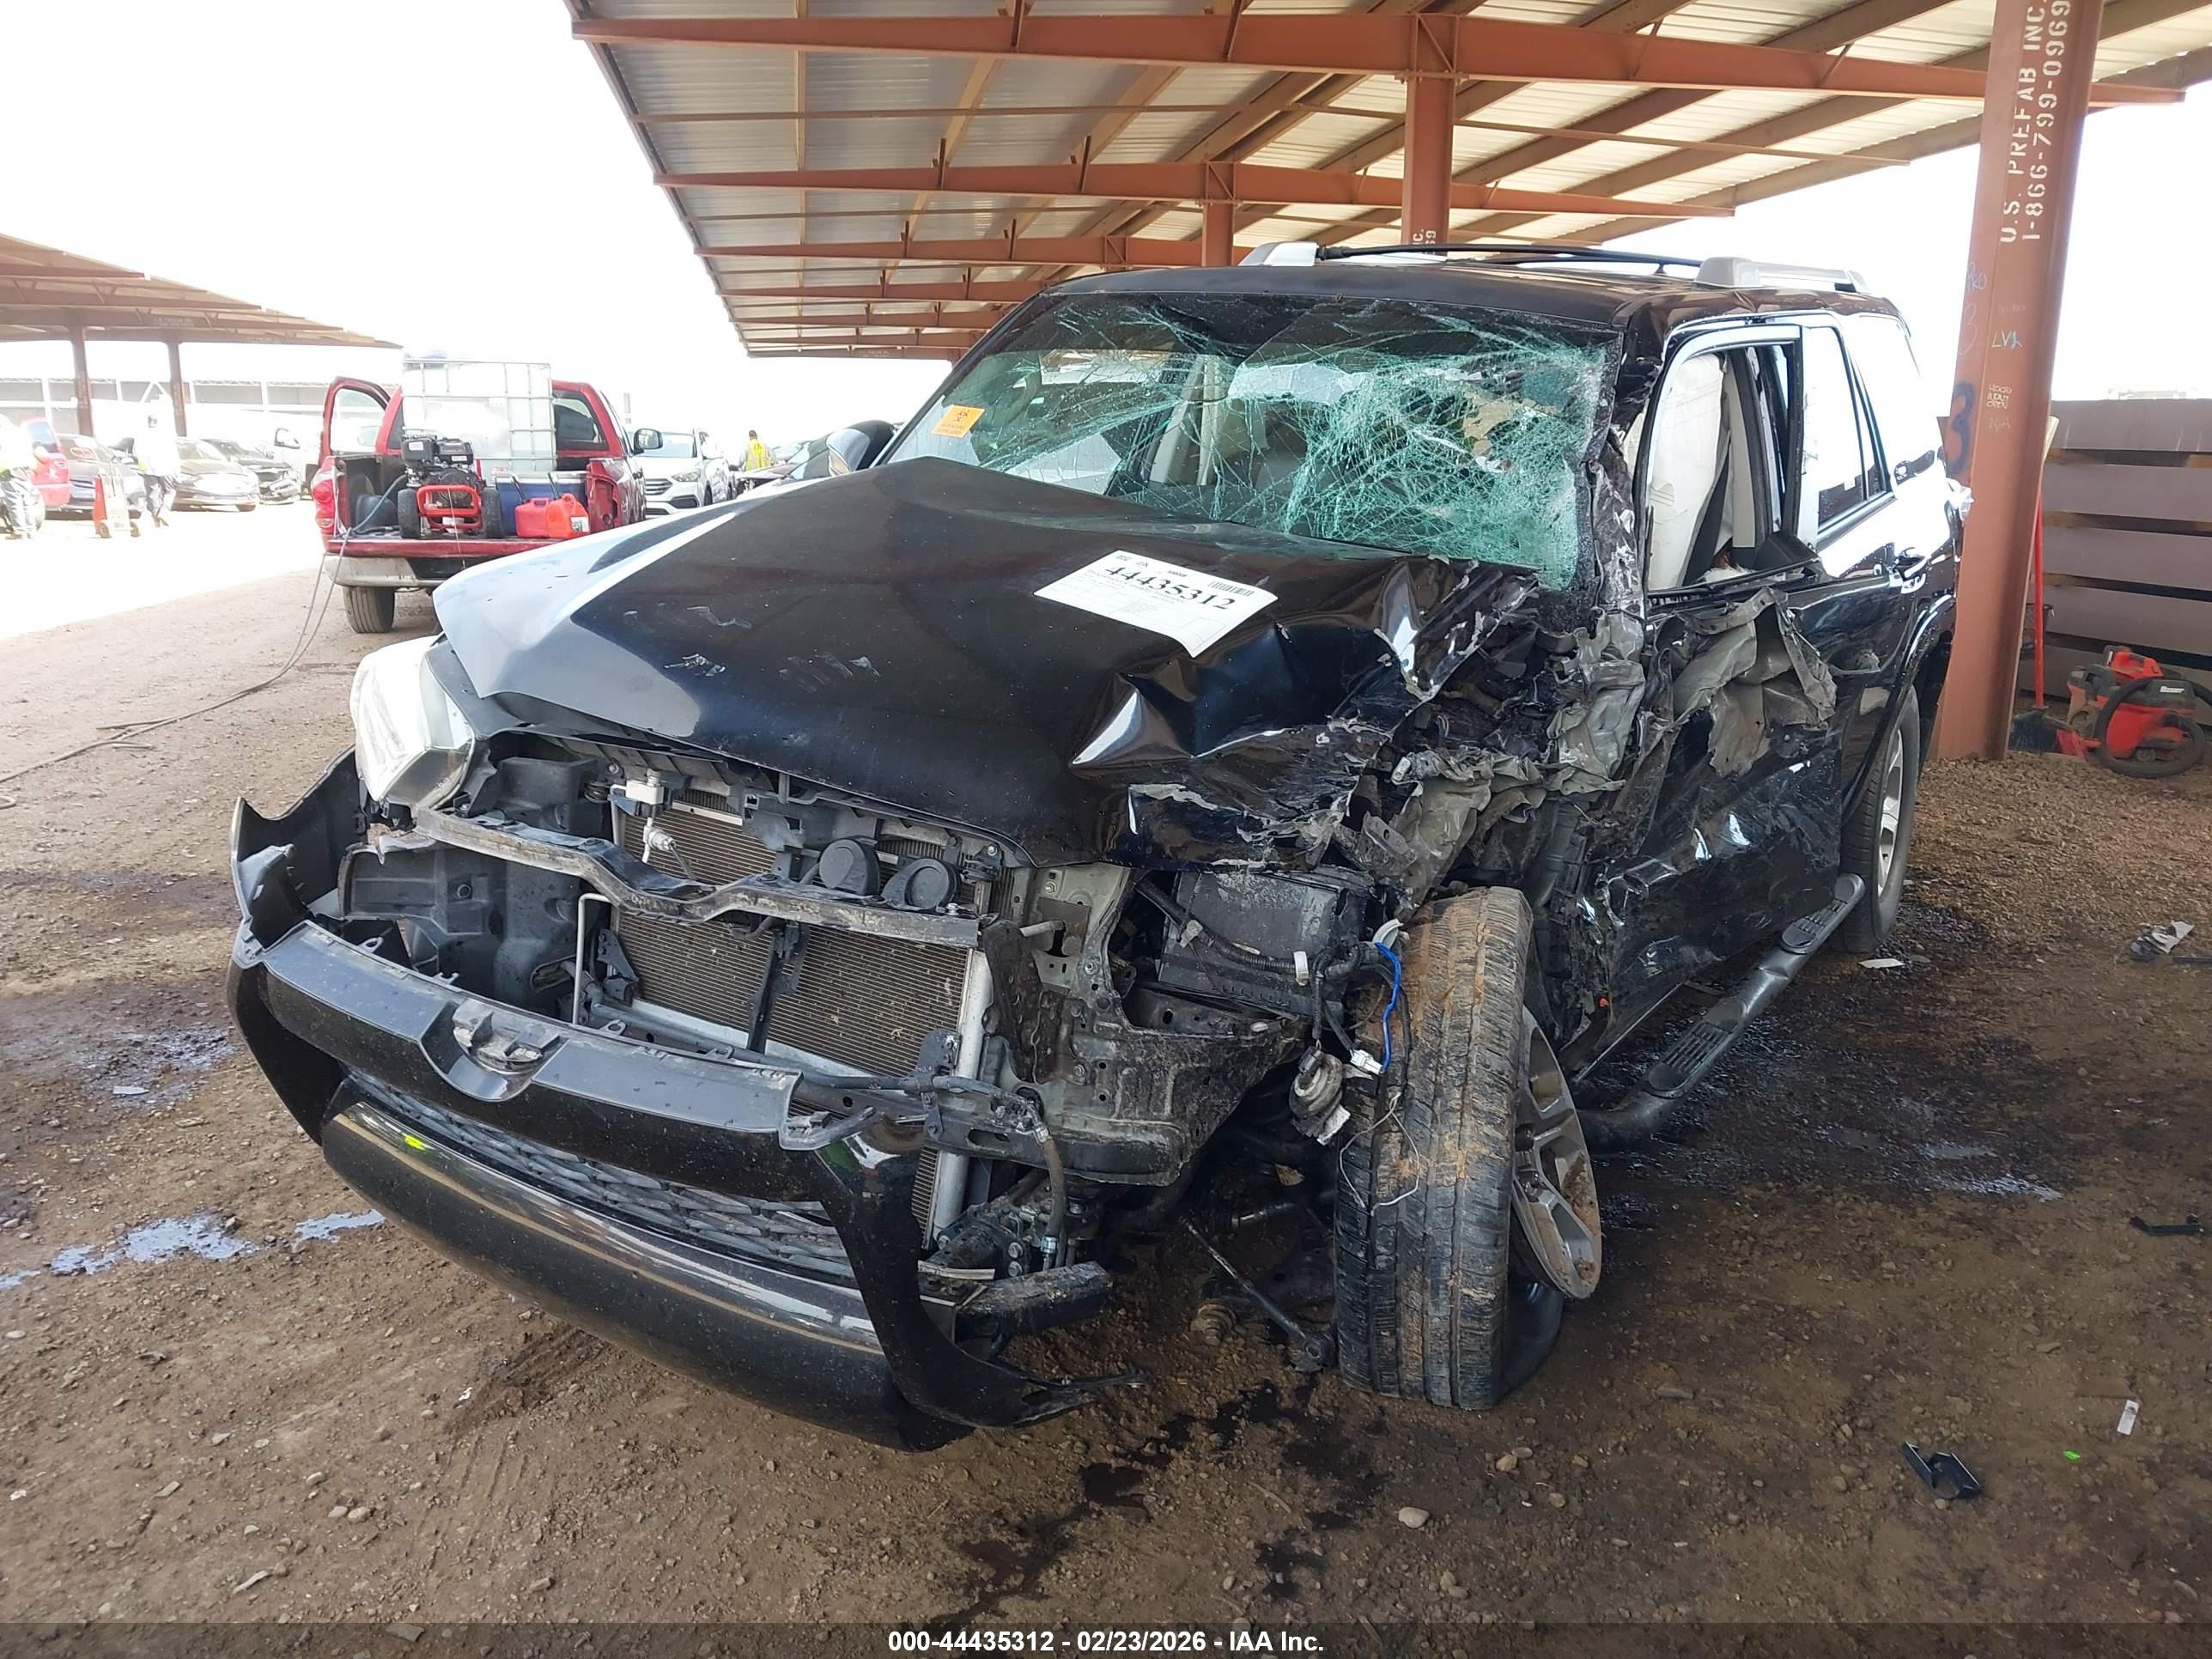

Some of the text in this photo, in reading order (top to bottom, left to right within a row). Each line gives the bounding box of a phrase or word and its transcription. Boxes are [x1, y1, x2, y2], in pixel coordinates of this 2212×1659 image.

[2008, 67, 2037, 175] PREFAB
[2021, 0, 2071, 240] 1-866-799-0969
[2000, 193, 2021, 243] U.S.
[1105, 567, 1236, 611] 44435312
